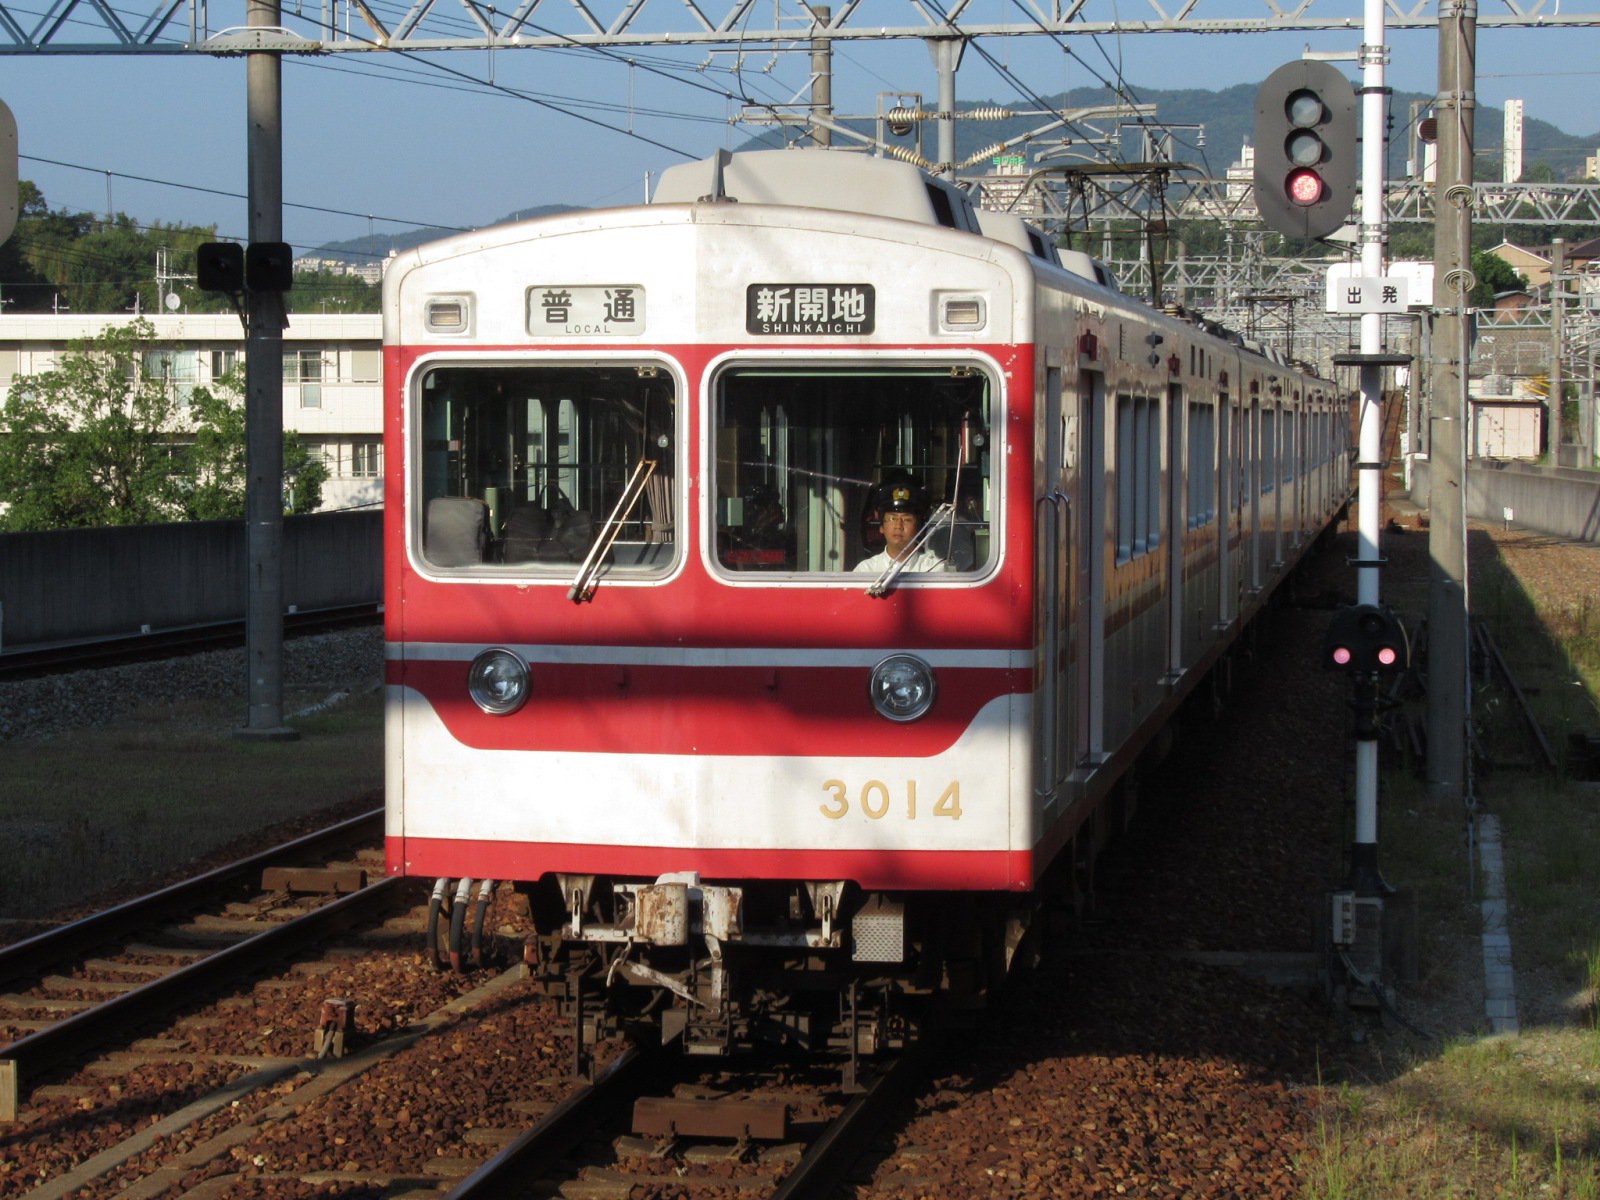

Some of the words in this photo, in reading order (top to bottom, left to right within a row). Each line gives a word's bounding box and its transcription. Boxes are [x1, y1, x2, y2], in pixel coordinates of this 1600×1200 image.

[541, 289, 635, 323] 普通
[757, 287, 866, 323] 新開地
[1347, 286, 1397, 304] 出発
[565, 324, 611, 334] LOCAL
[762, 323, 861, 333] SHINKAICHI
[819, 778, 963, 821] 3014
